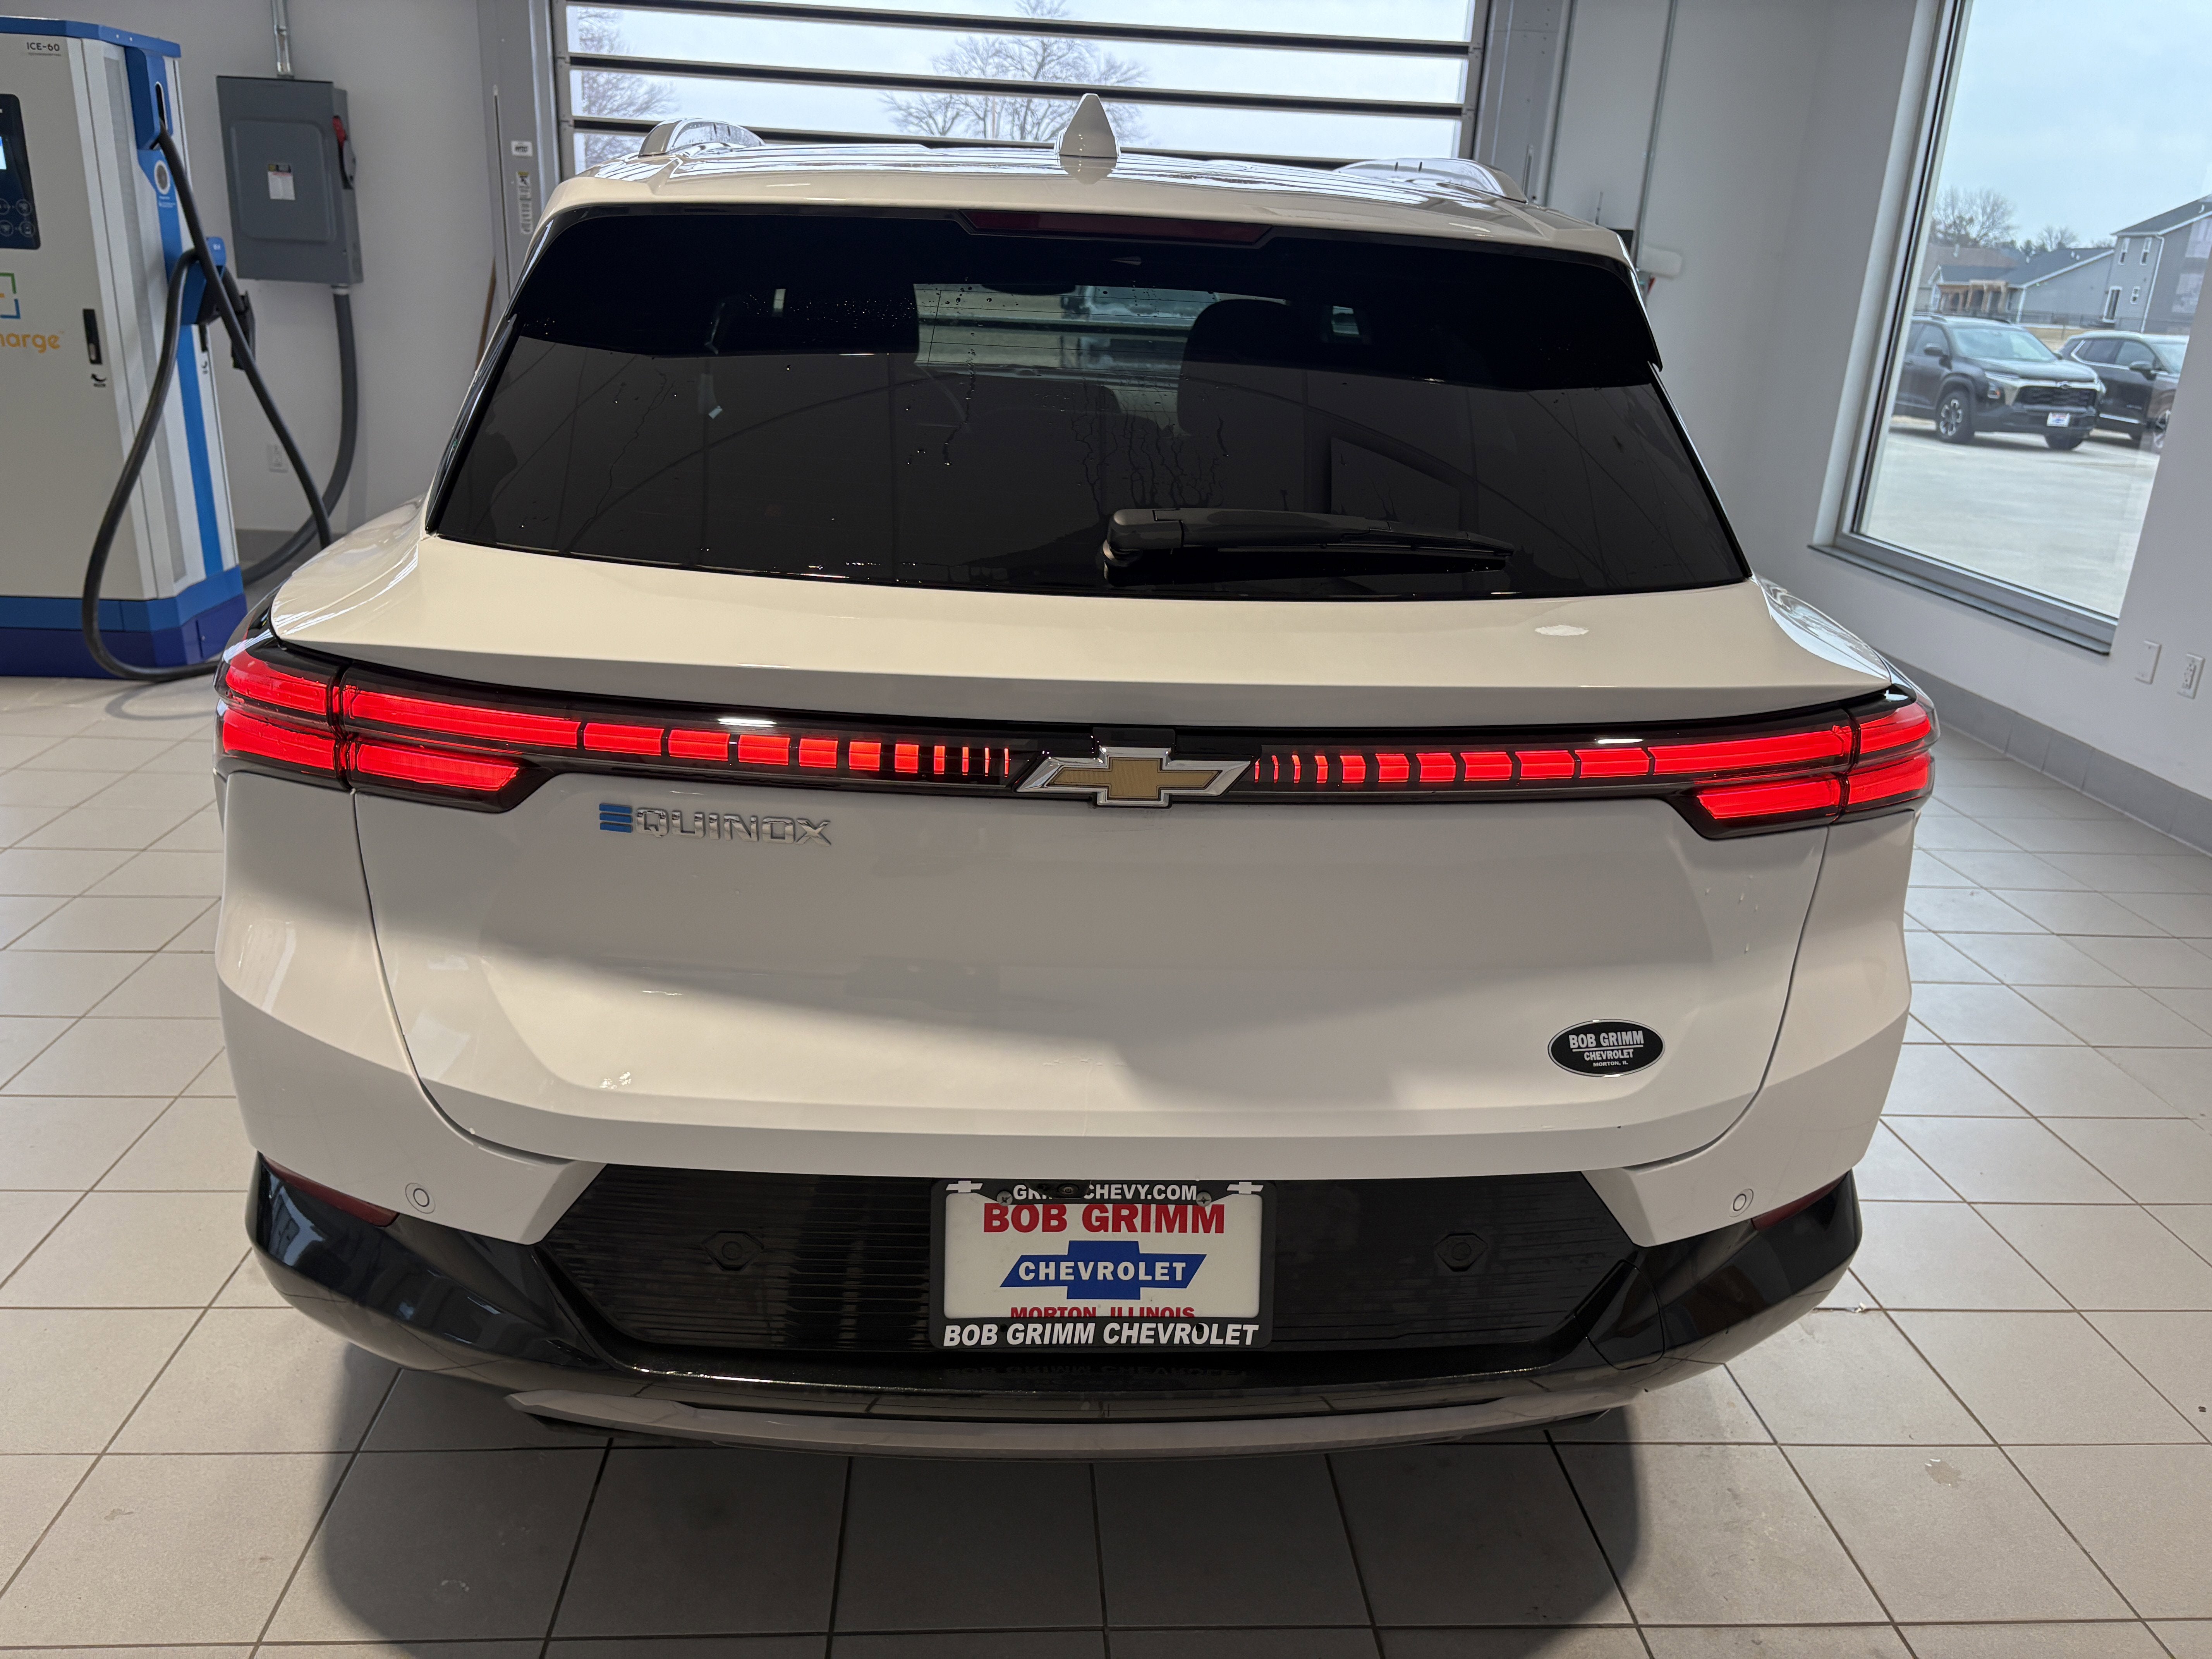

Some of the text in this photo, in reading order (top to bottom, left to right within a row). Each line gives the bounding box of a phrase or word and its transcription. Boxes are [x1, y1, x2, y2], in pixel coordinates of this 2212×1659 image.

[26, 42, 60, 51] ICE-60
[599, 803, 831, 846] EQUINOX
[1569, 1030, 1644, 1049] BOB GRIMM
[1584, 1049, 1634, 1061] CHEVROLET
[983, 1203, 1224, 1234] BOB GRIMM
[1019, 1261, 1186, 1281] CHEVROLET
[943, 1322, 1259, 1346] BOB GRIMM CHEVROLET
